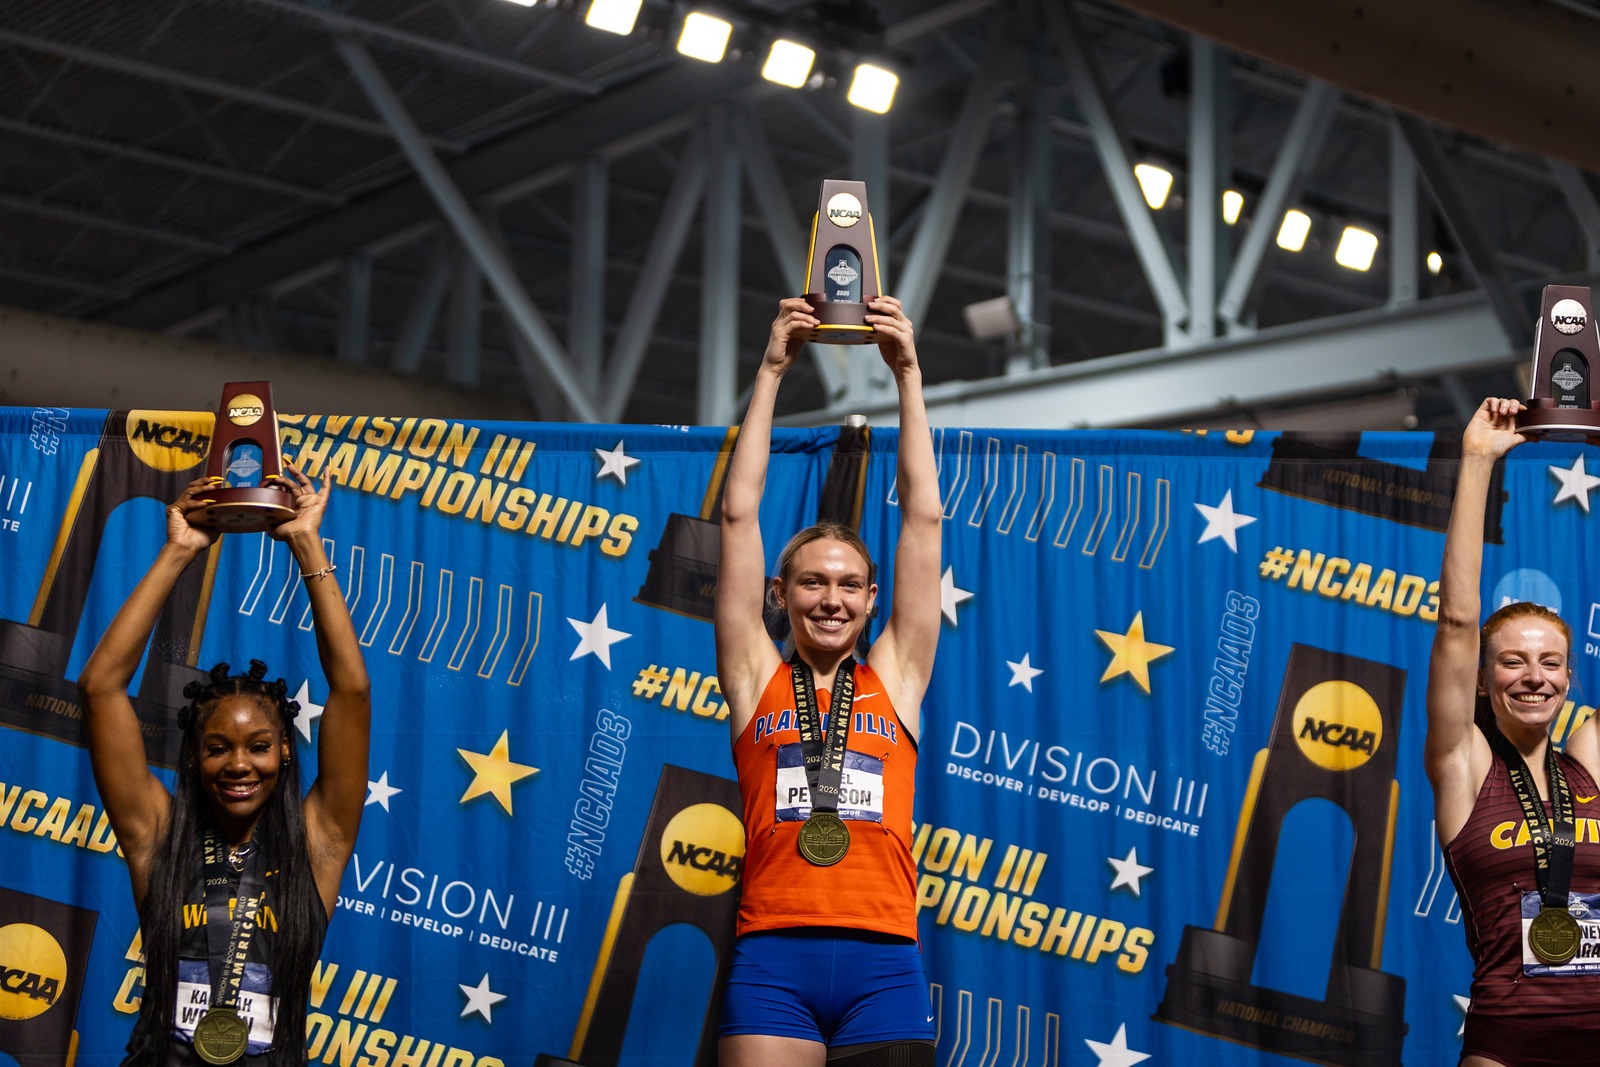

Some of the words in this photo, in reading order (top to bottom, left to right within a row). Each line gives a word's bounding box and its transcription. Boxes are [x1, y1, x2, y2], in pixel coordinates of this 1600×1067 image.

[830, 209, 862, 219] NCAA
[1554, 315, 1586, 326] NCAA
[229, 406, 262, 418] NCAA
[132, 418, 210, 459] NCAA
[480, 434, 536, 482] III
[1202, 590, 1260, 756] #NCAAD3
[25, 692, 82, 720] NATIONA
[1299, 716, 1376, 756] NCAA
[820, 785, 838, 795] 2026
[950, 720, 1156, 804] DIVISION
[1173, 777, 1208, 818] III
[564, 708, 632, 880] #NCAAD3
[788, 786, 871, 806] PESON
[946, 762, 1024, 793] DISCOVER
[1038, 786, 1110, 813] DEVELOP
[1124, 807, 1200, 838] DEDICATE
[0, 782, 124, 858] NCAAD
[1510, 770, 1548, 870] ALL-AMERICAN
[667, 840, 742, 882] NCAA
[1554, 838, 1575, 848] 2026
[206, 877, 228, 886] 2026
[994, 844, 1048, 896] III
[390, 910, 464, 938] DEVELOP
[479, 933, 558, 963] DEDICATE
[531, 901, 569, 944] III
[0, 965, 59, 1005] CAA
[338, 970, 398, 1023] III
[1216, 999, 1278, 1026] NATIONAL
[1281, 1014, 1357, 1044] CHAMPION
